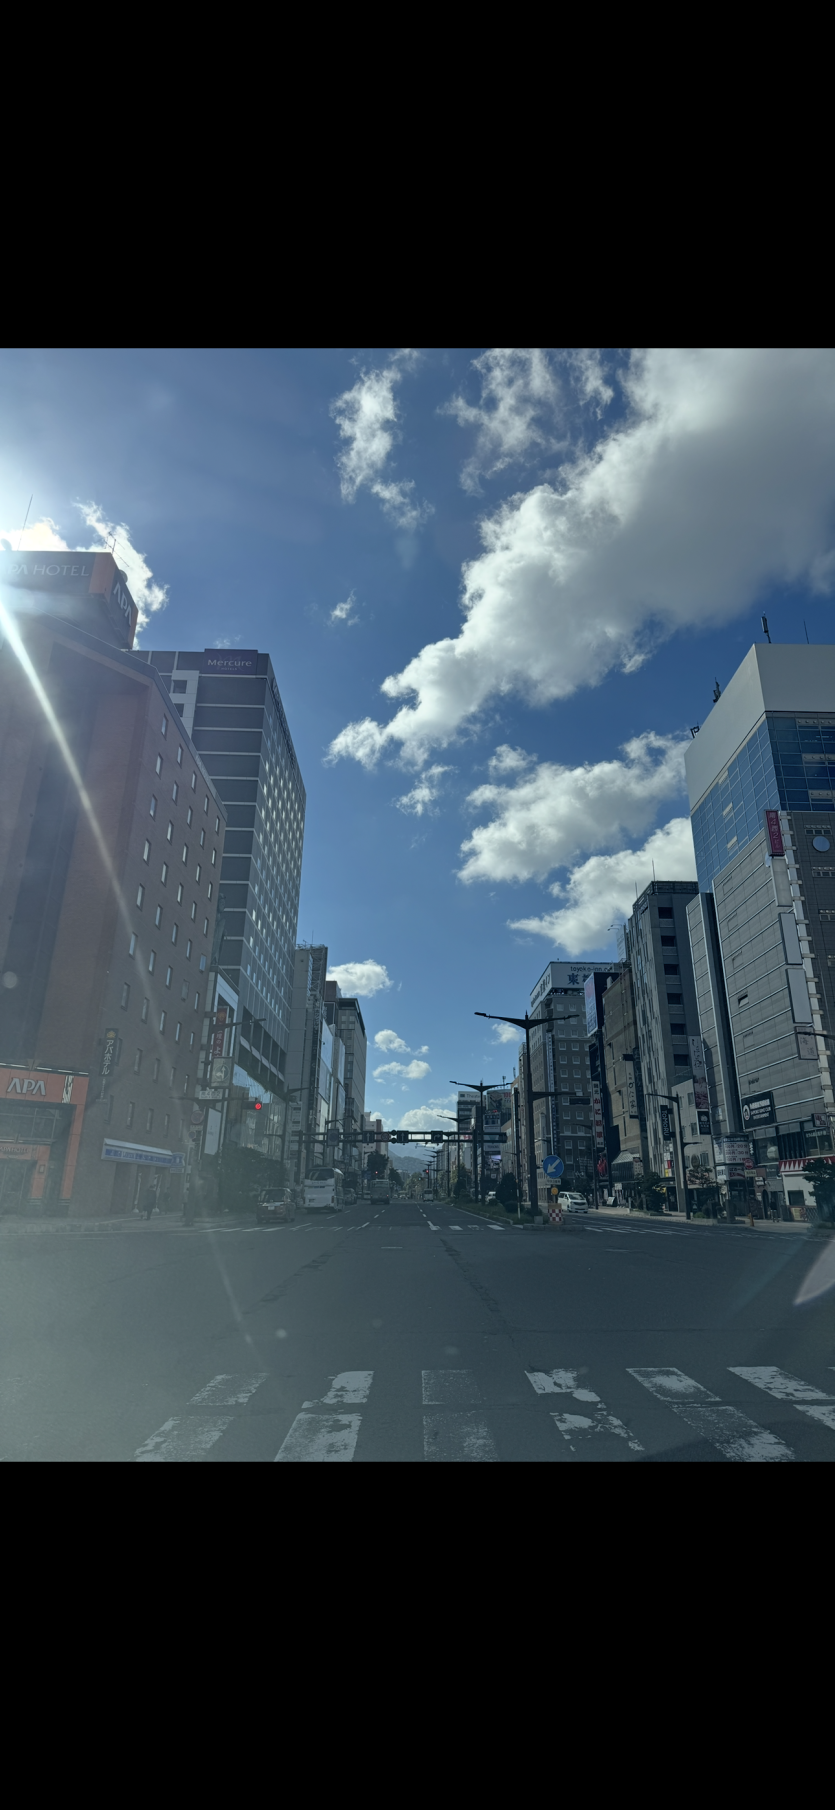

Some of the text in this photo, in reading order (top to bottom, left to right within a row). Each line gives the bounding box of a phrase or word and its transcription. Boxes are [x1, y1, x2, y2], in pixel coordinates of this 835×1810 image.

[33, 565, 90, 577] HOTEL
[113, 582, 132, 627] APA
[207, 659, 253, 667] Mercure
[101, 1039, 114, 1075] アパホテル
[7, 1077, 46, 1096] APA
[661, 1109, 670, 1136] TOMORU
